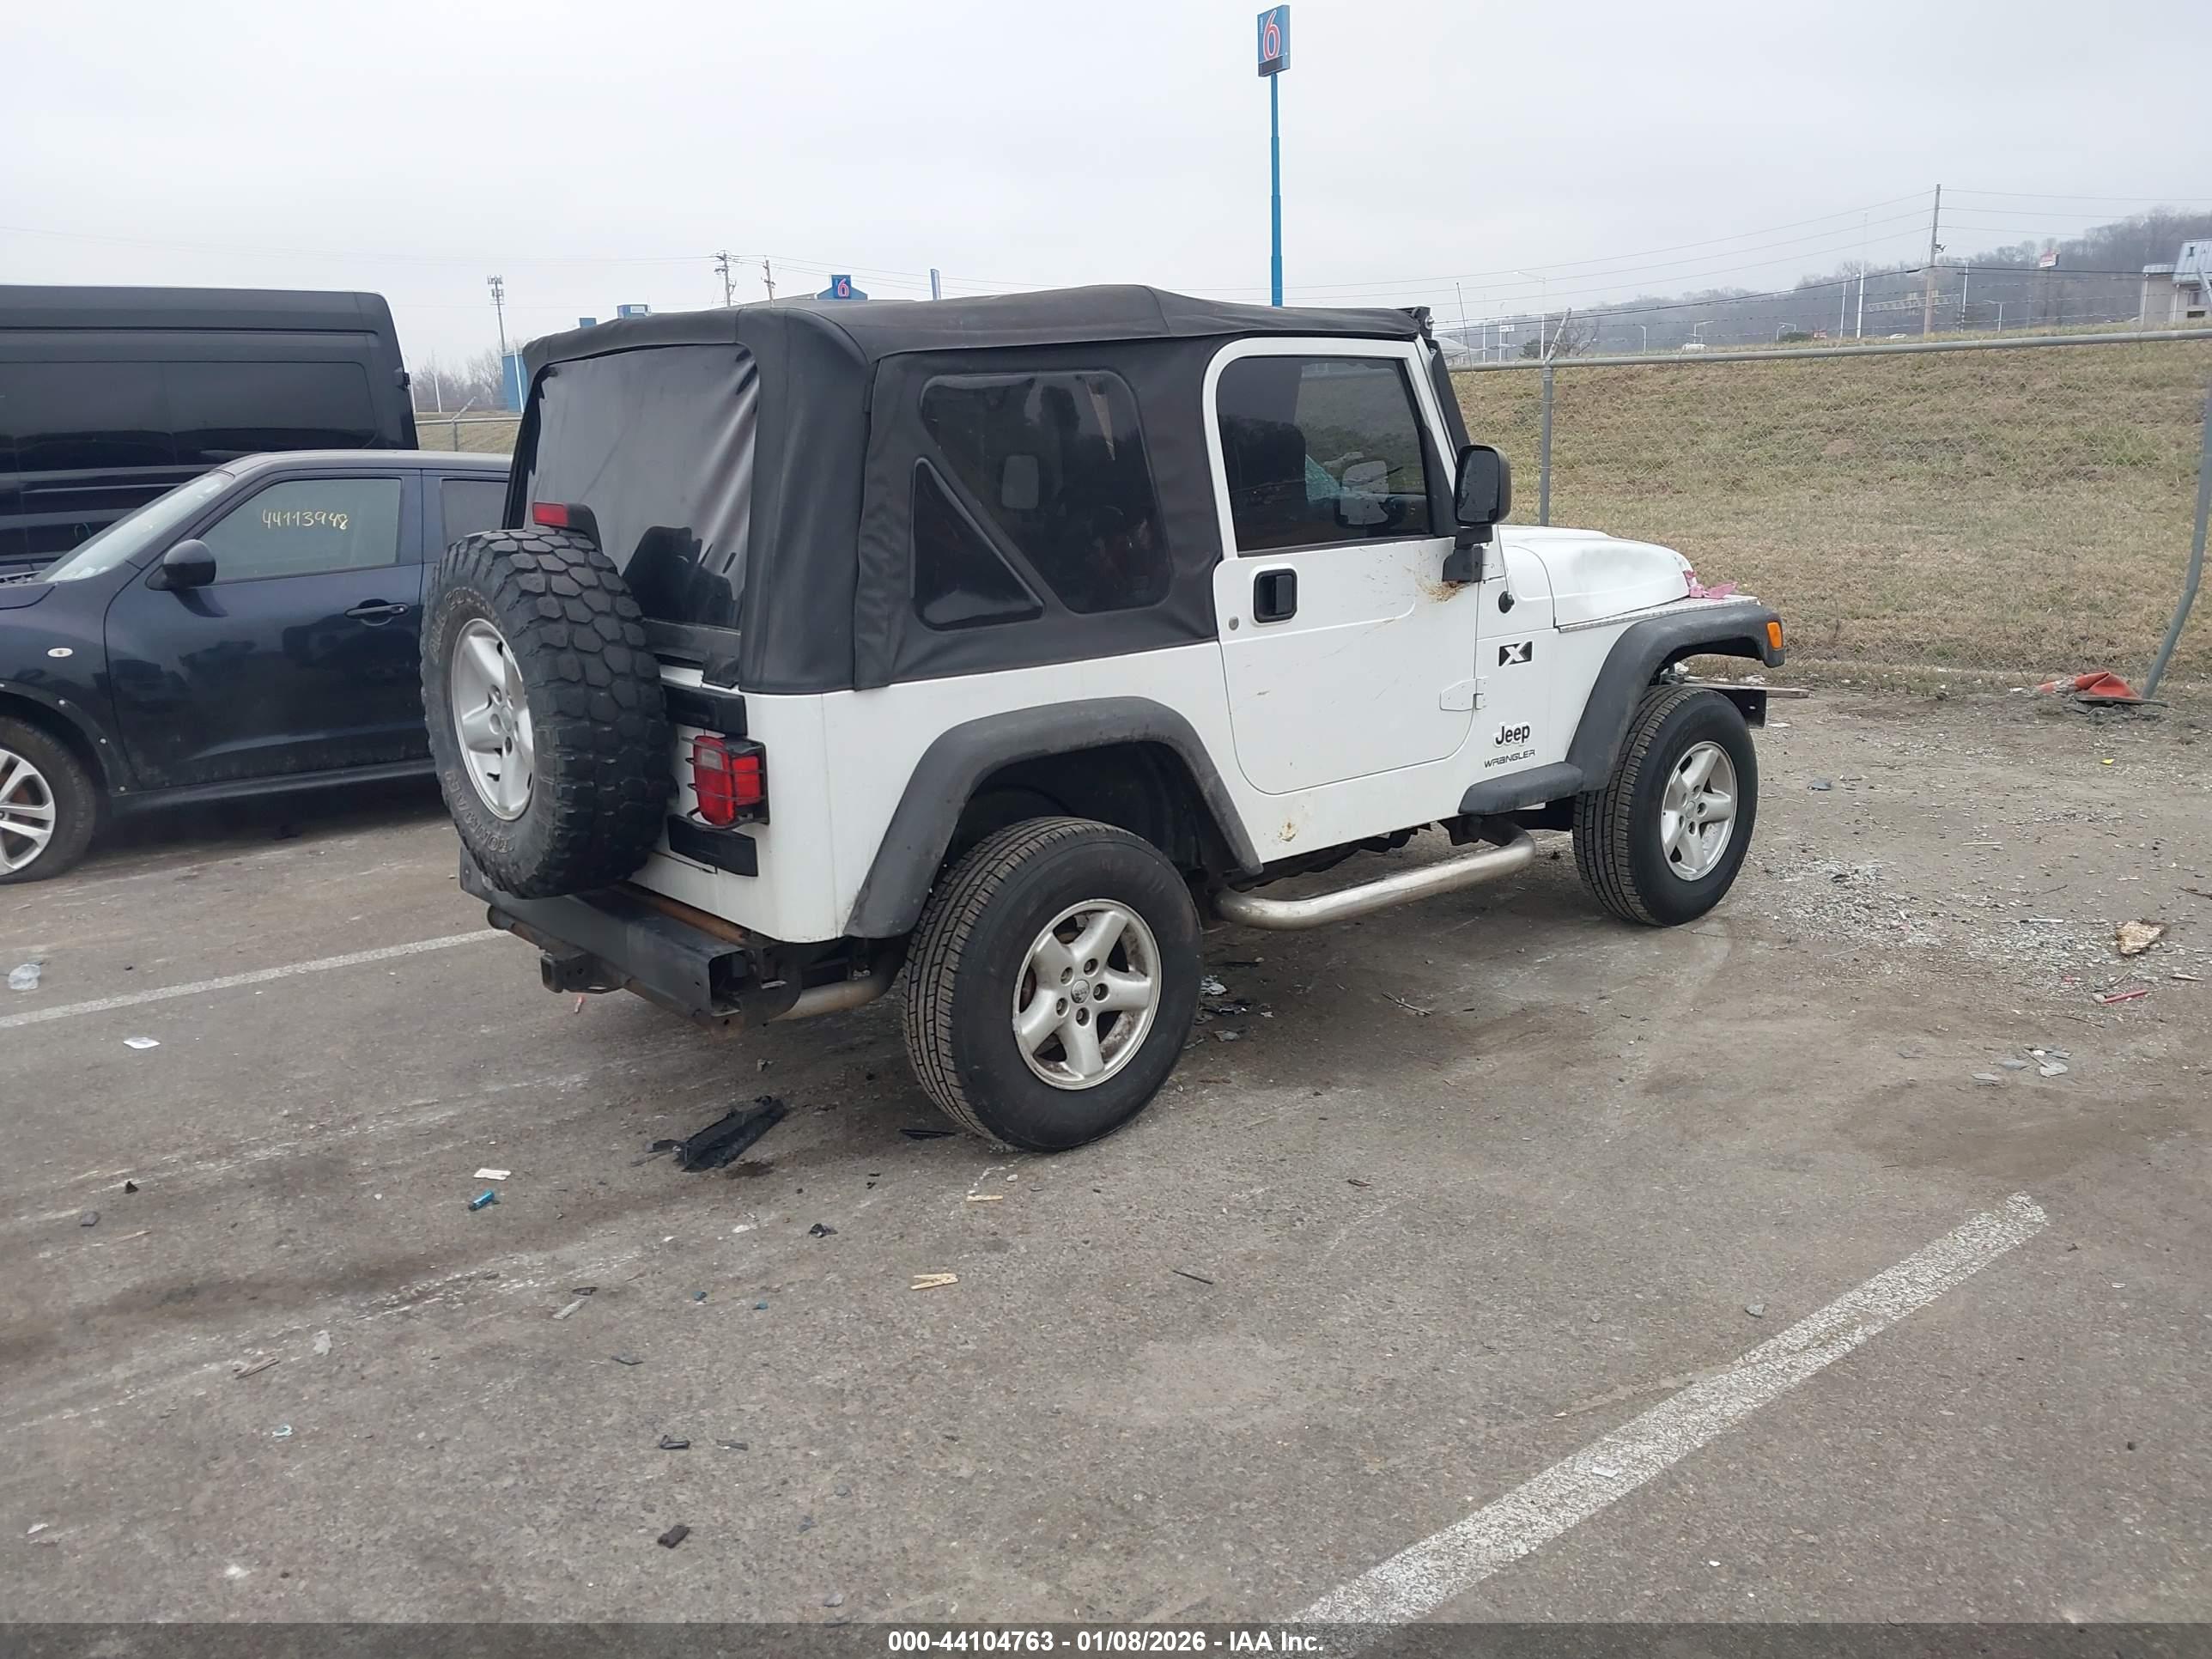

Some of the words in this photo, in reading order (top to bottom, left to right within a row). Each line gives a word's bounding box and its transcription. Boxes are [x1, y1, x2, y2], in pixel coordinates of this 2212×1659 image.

[1263, 9, 1280, 60] 6
[838, 277, 849, 297] 6
[262, 508, 349, 530] 44113948
[1498, 641, 1533, 666] X
[1495, 725, 1530, 745] Jeep
[1484, 749, 1535, 769] WRANGLER
